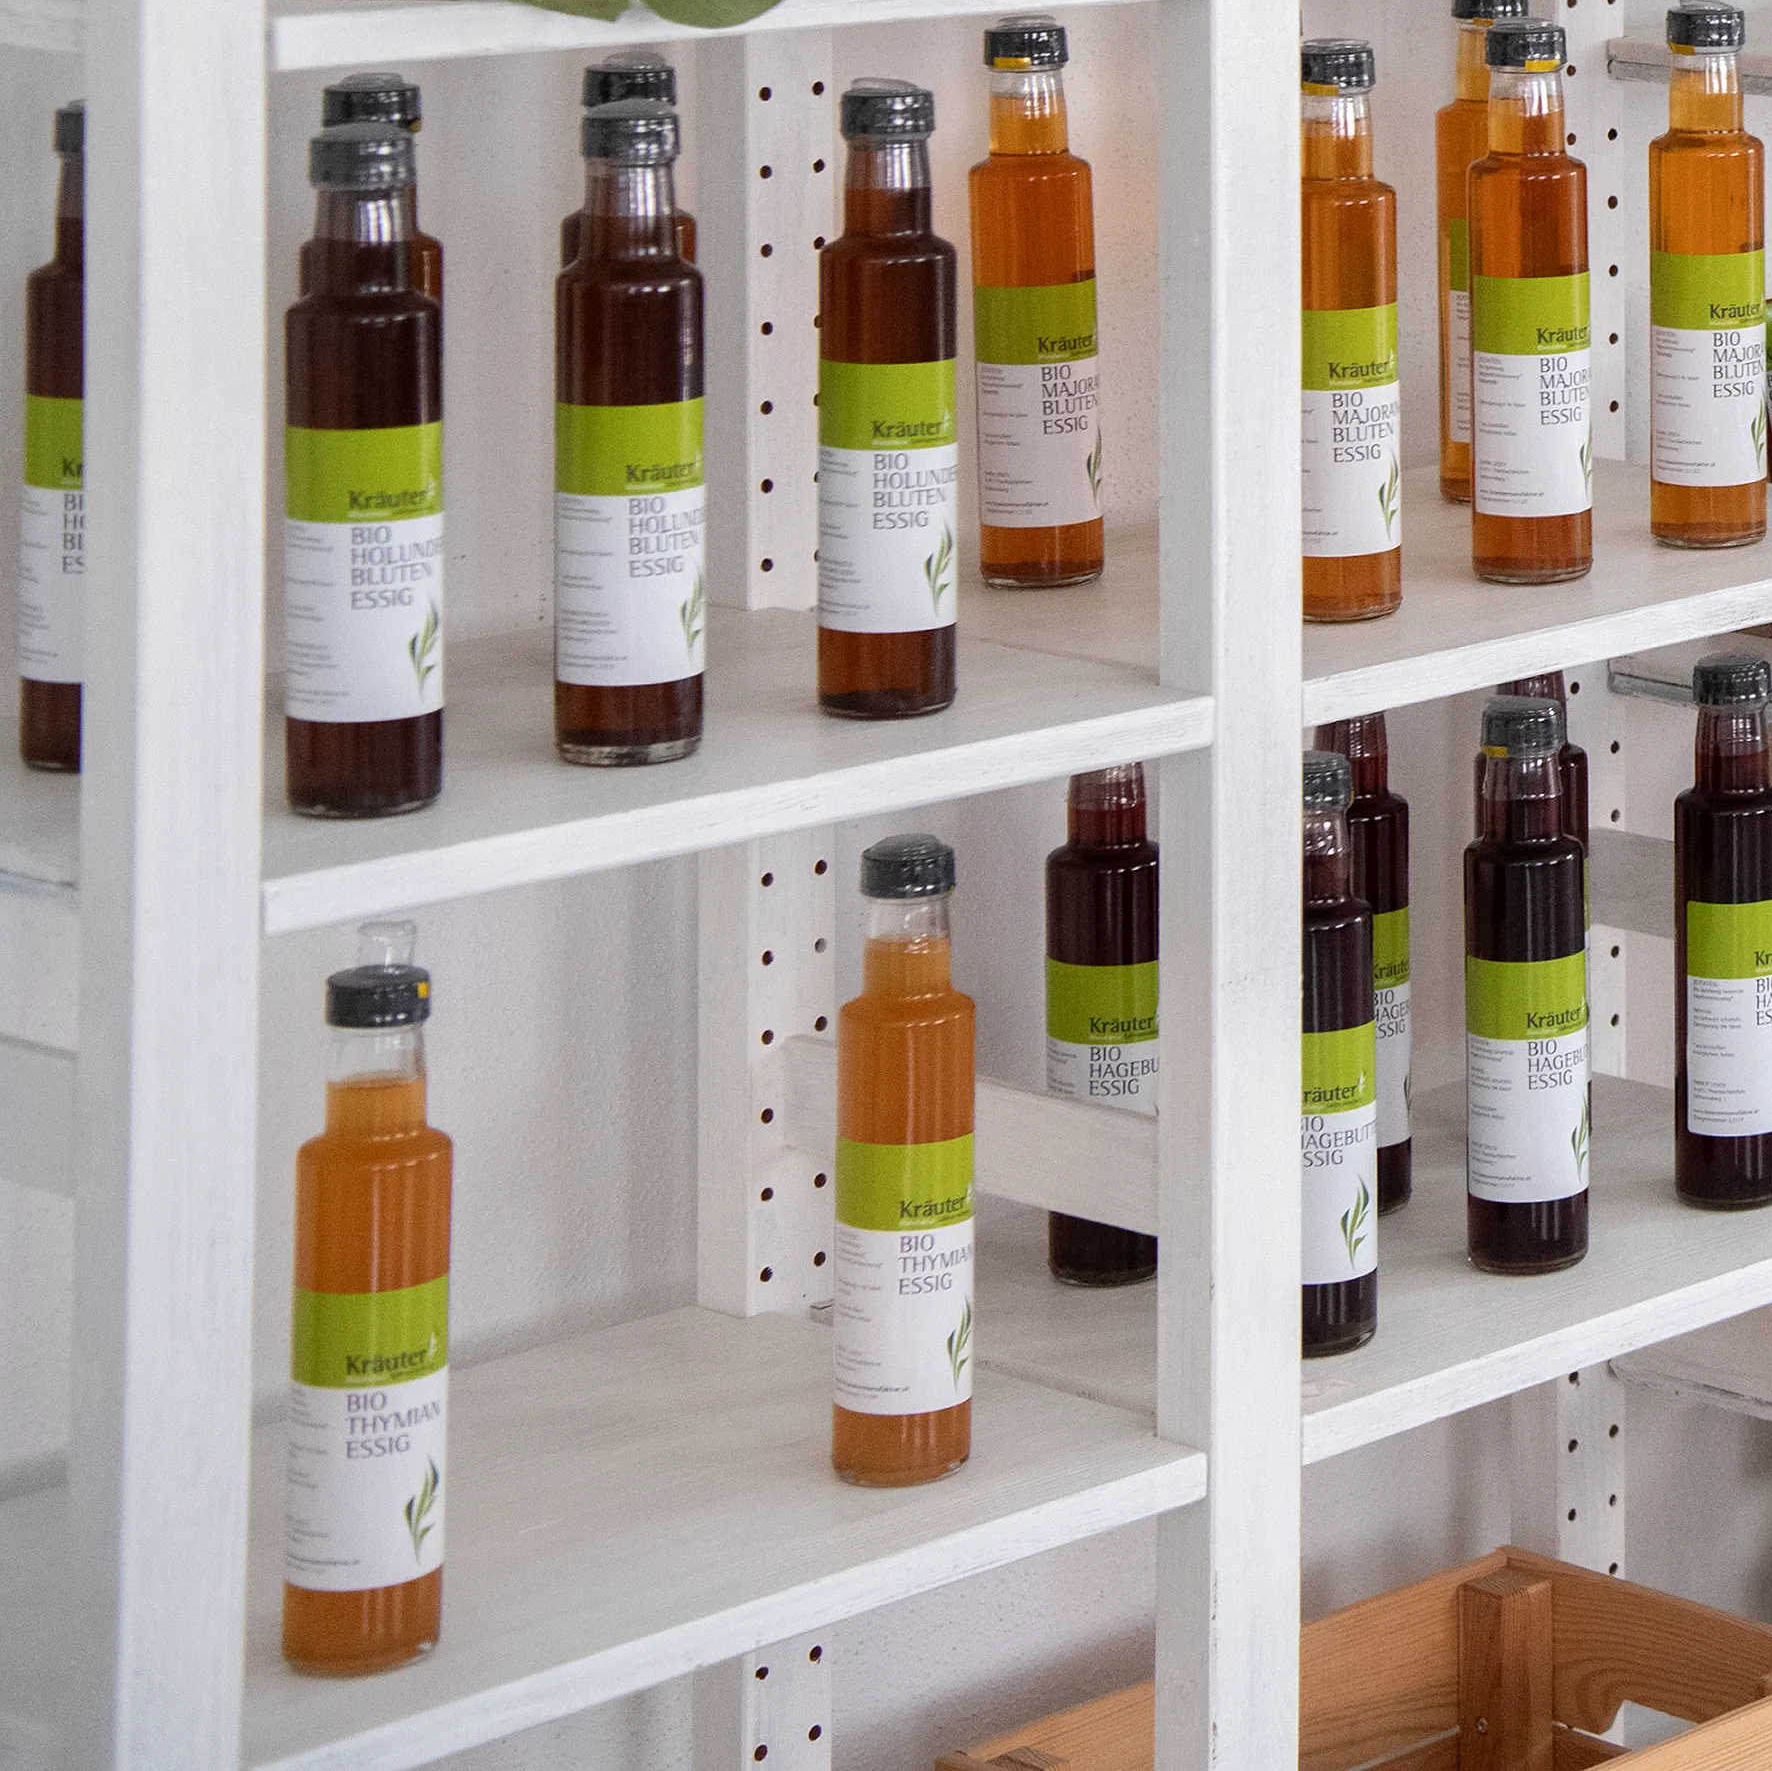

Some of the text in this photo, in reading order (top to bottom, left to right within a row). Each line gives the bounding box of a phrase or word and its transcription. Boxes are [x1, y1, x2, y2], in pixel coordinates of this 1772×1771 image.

[1709, 302, 1763, 322] Kräuter
[1037, 332, 1094, 355] Kräuter
[1537, 324, 1590, 346] Kräuter
[1713, 332, 1742, 348] BIO
[1041, 365, 1073, 383] BIO
[1328, 359, 1390, 380] Kräuter
[1539, 357, 1569, 374] BIO
[1332, 391, 1365, 409] BIO
[1713, 380, 1756, 399] ESSIG
[1043, 417, 1090, 436] ESSIG
[1541, 407, 1583, 426] ESSIG
[871, 419, 943, 441] Kräuter
[873, 452, 910, 472] BIO
[1333, 445, 1382, 465] ESSIG
[628, 495, 668, 517] BIO
[873, 509, 932, 531] ESSIG
[350, 527, 393, 547] BIO
[629, 556, 685, 579] ESSIG
[350, 588, 415, 611] ESSIG
[1089, 1014, 1153, 1035] Kräuter
[1526, 1007, 1582, 1030] Kräuter
[1089, 1046, 1122, 1063] BIO
[1527, 1039, 1558, 1057] BIO
[1089, 1077, 1141, 1097] ESSIG
[1527, 1070, 1574, 1090] ESSIG
[1301, 1082, 1358, 1104] räuter
[1301, 1147, 1344, 1167] SSIG
[898, 1193, 966, 1220] Kräuter
[899, 1233, 936, 1254] BIO
[898, 1274, 953, 1296] ESSIG
[346, 1347, 428, 1376] Kräuter
[347, 1391, 388, 1413] BIO
[347, 1398, 442, 1436] THYMIAN
[346, 1433, 411, 1460] ESSIG
